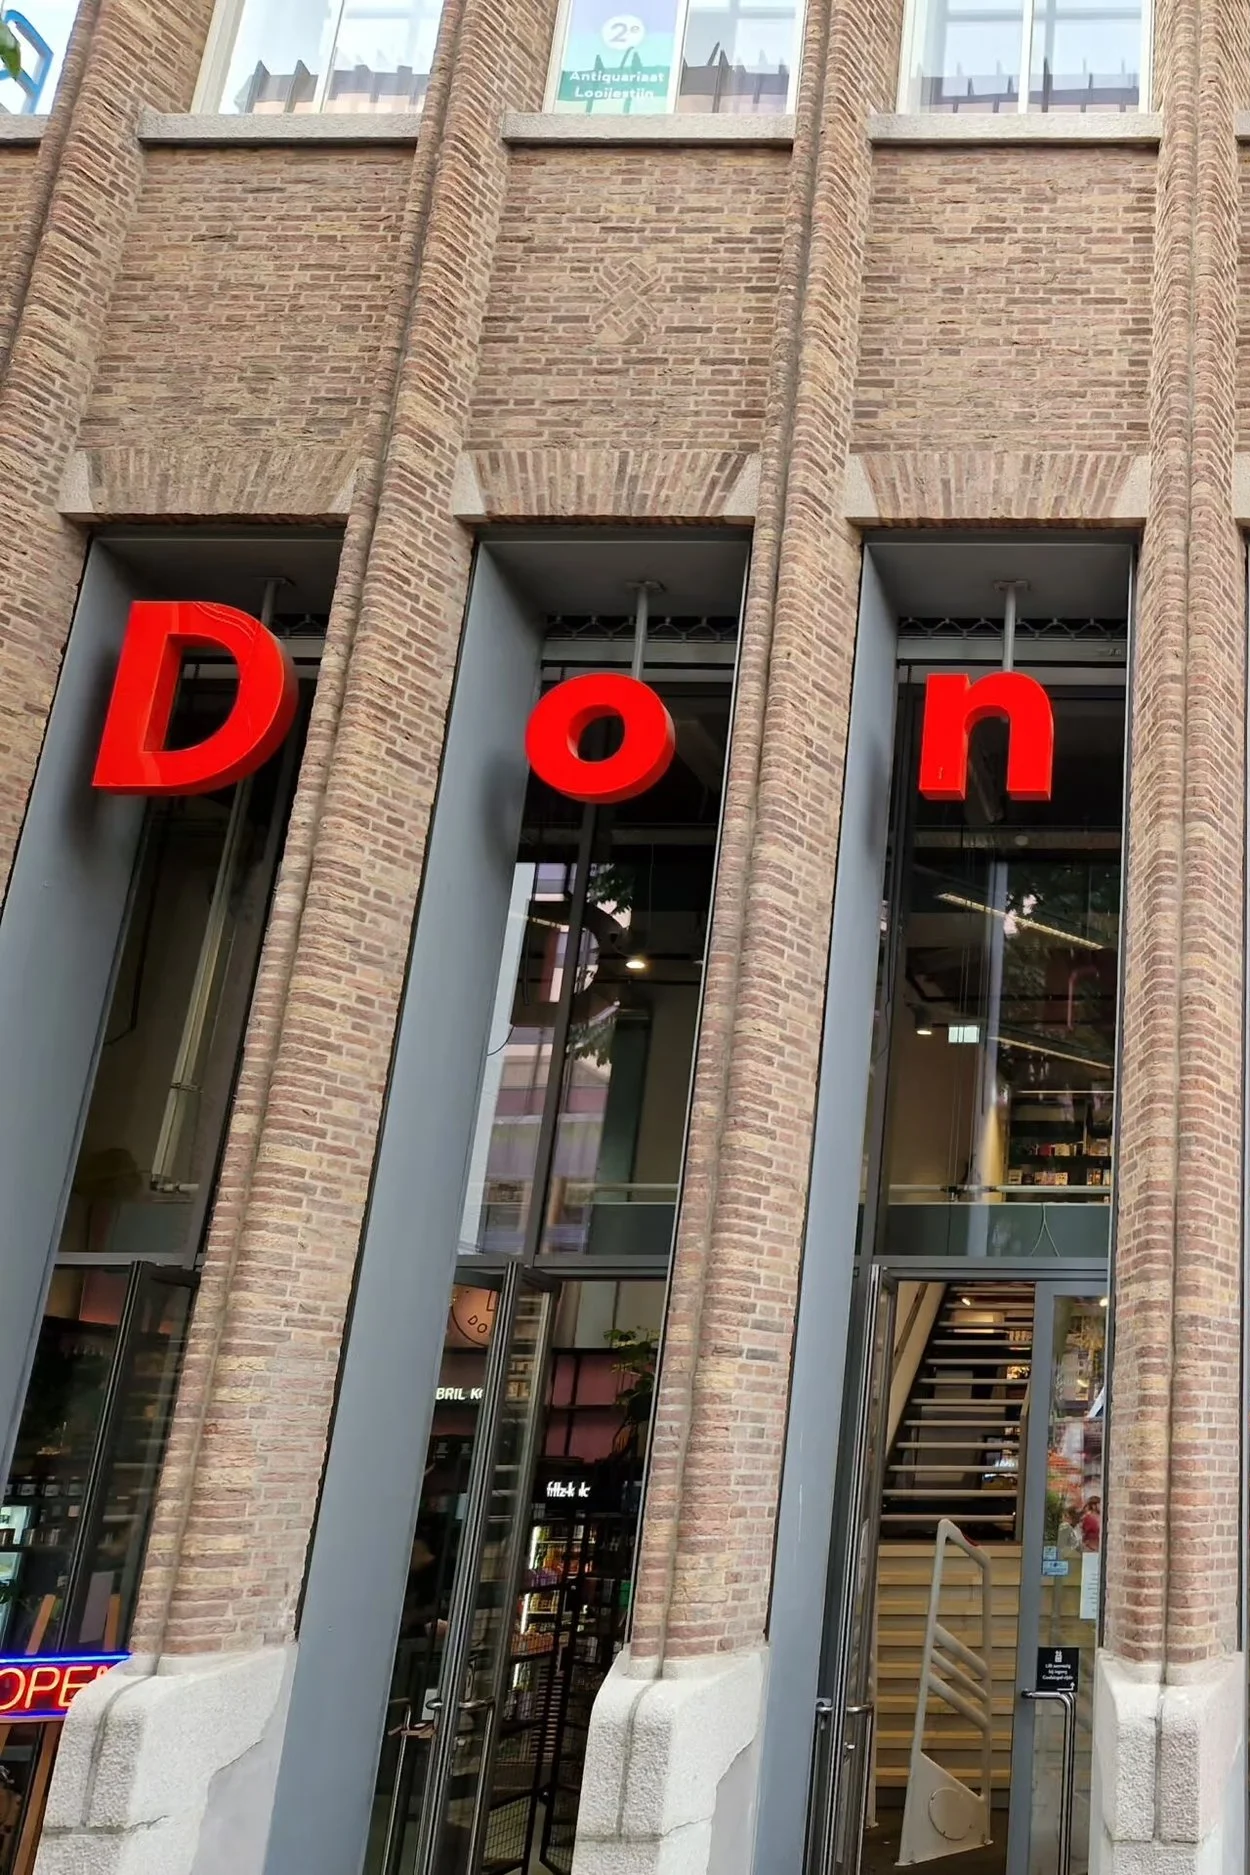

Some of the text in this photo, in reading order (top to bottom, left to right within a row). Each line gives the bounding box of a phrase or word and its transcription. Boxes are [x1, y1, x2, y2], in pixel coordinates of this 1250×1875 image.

[569, 71, 665, 84] Antiquariaat
[546, 1480, 591, 1498] fritz-kl
[0, 1665, 108, 1710] OPE
